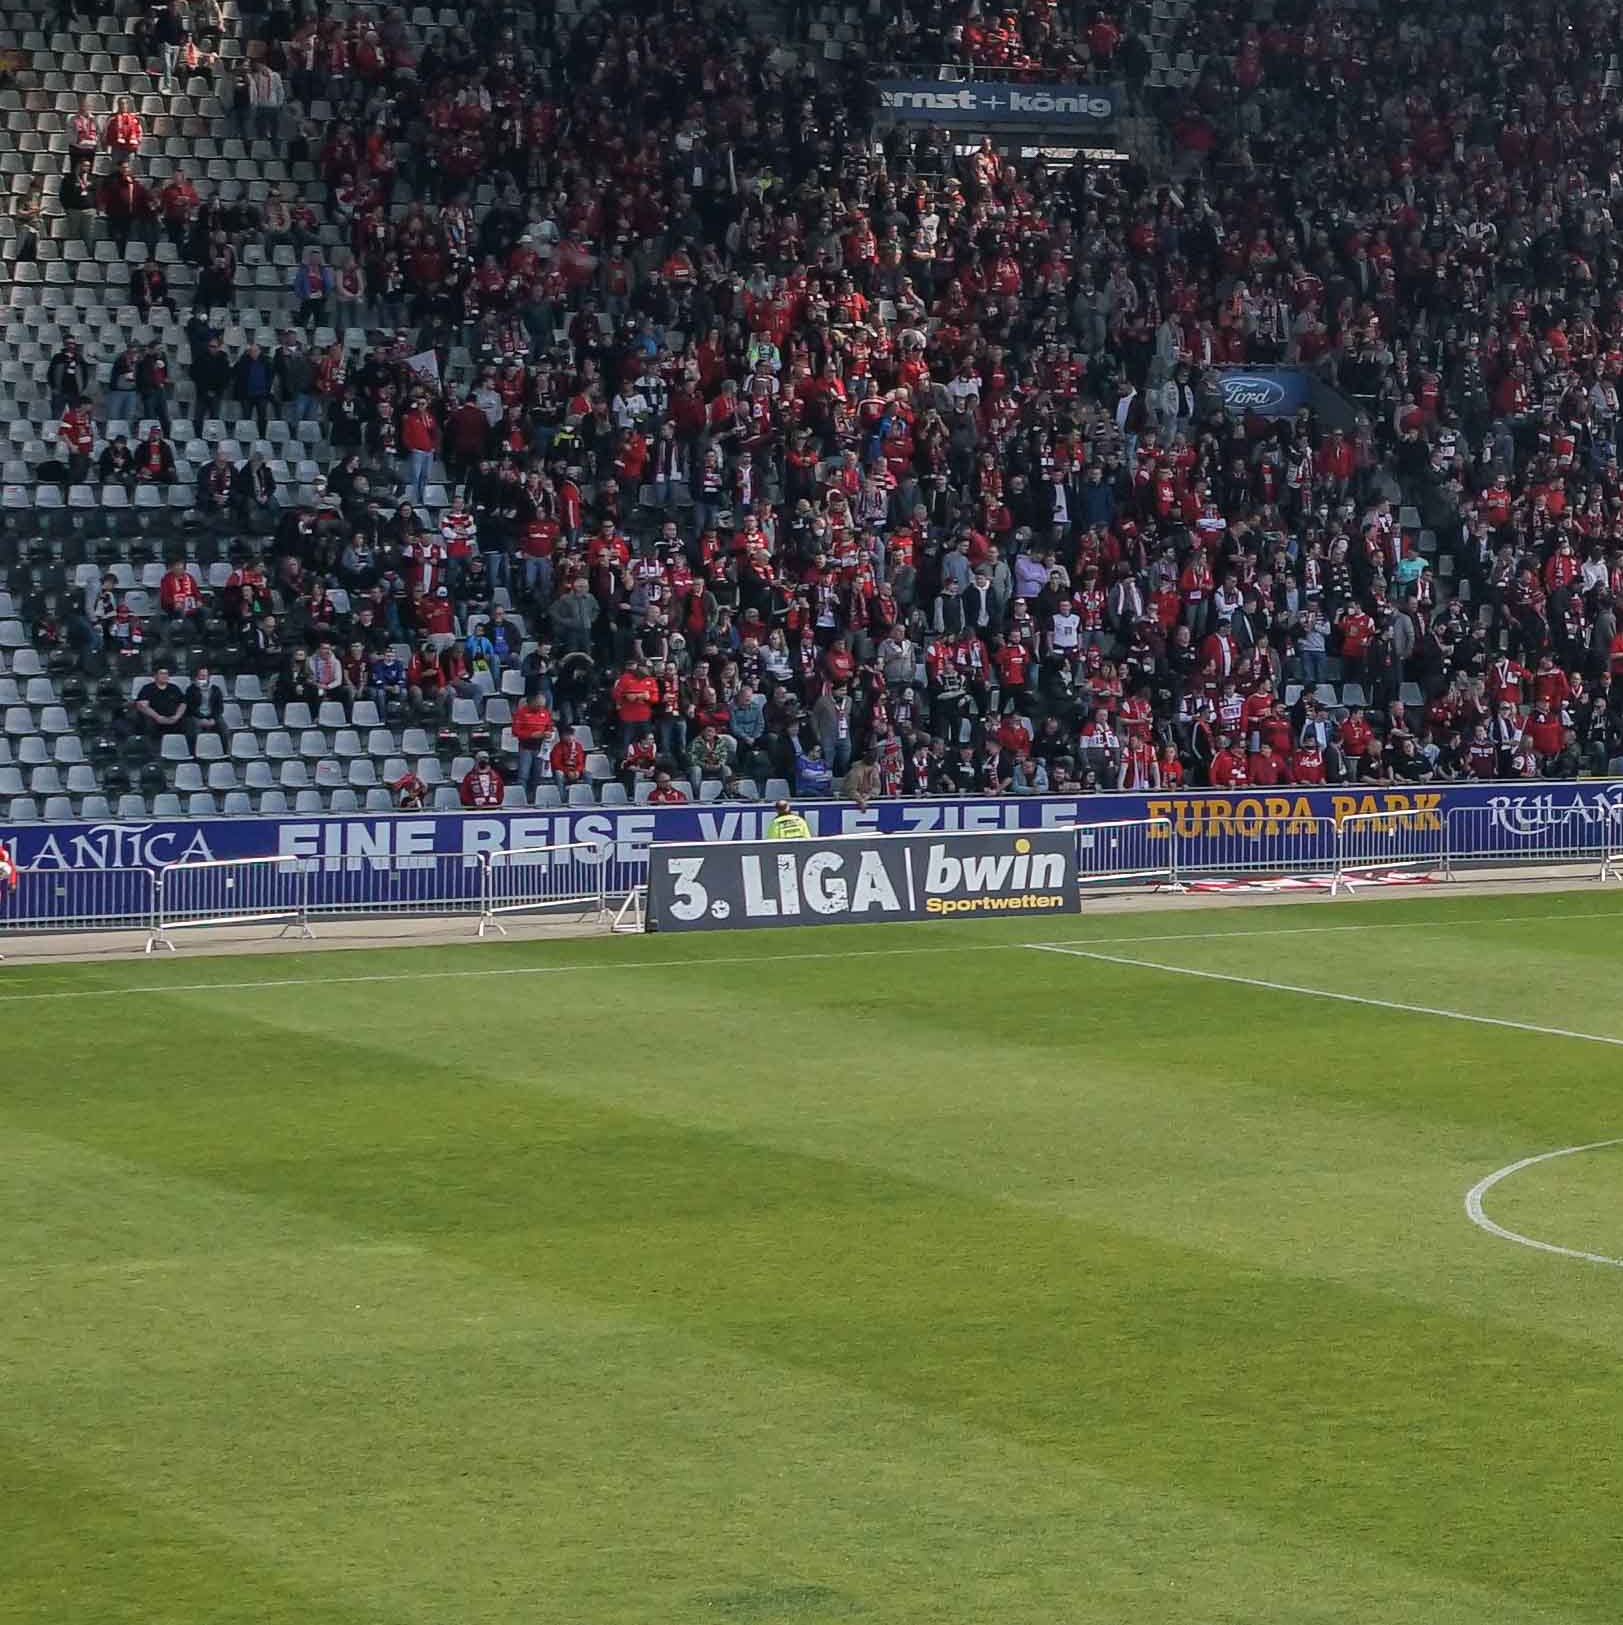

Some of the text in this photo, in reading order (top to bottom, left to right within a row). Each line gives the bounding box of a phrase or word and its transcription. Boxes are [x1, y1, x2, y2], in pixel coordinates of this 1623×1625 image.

[1010, 92, 1111, 117] könig
[1223, 380, 1271, 405] Ford
[279, 821, 437, 873] EINE
[463, 813, 654, 867] REISE
[698, 807, 878, 841] VIE
[1146, 792, 1442, 840] EUROPA PARK
[0, 823, 217, 871] LANTICA
[924, 838, 1066, 895] bwin
[668, 850, 901, 920] 3. LIGA
[925, 894, 1064, 915] Sportwetten
